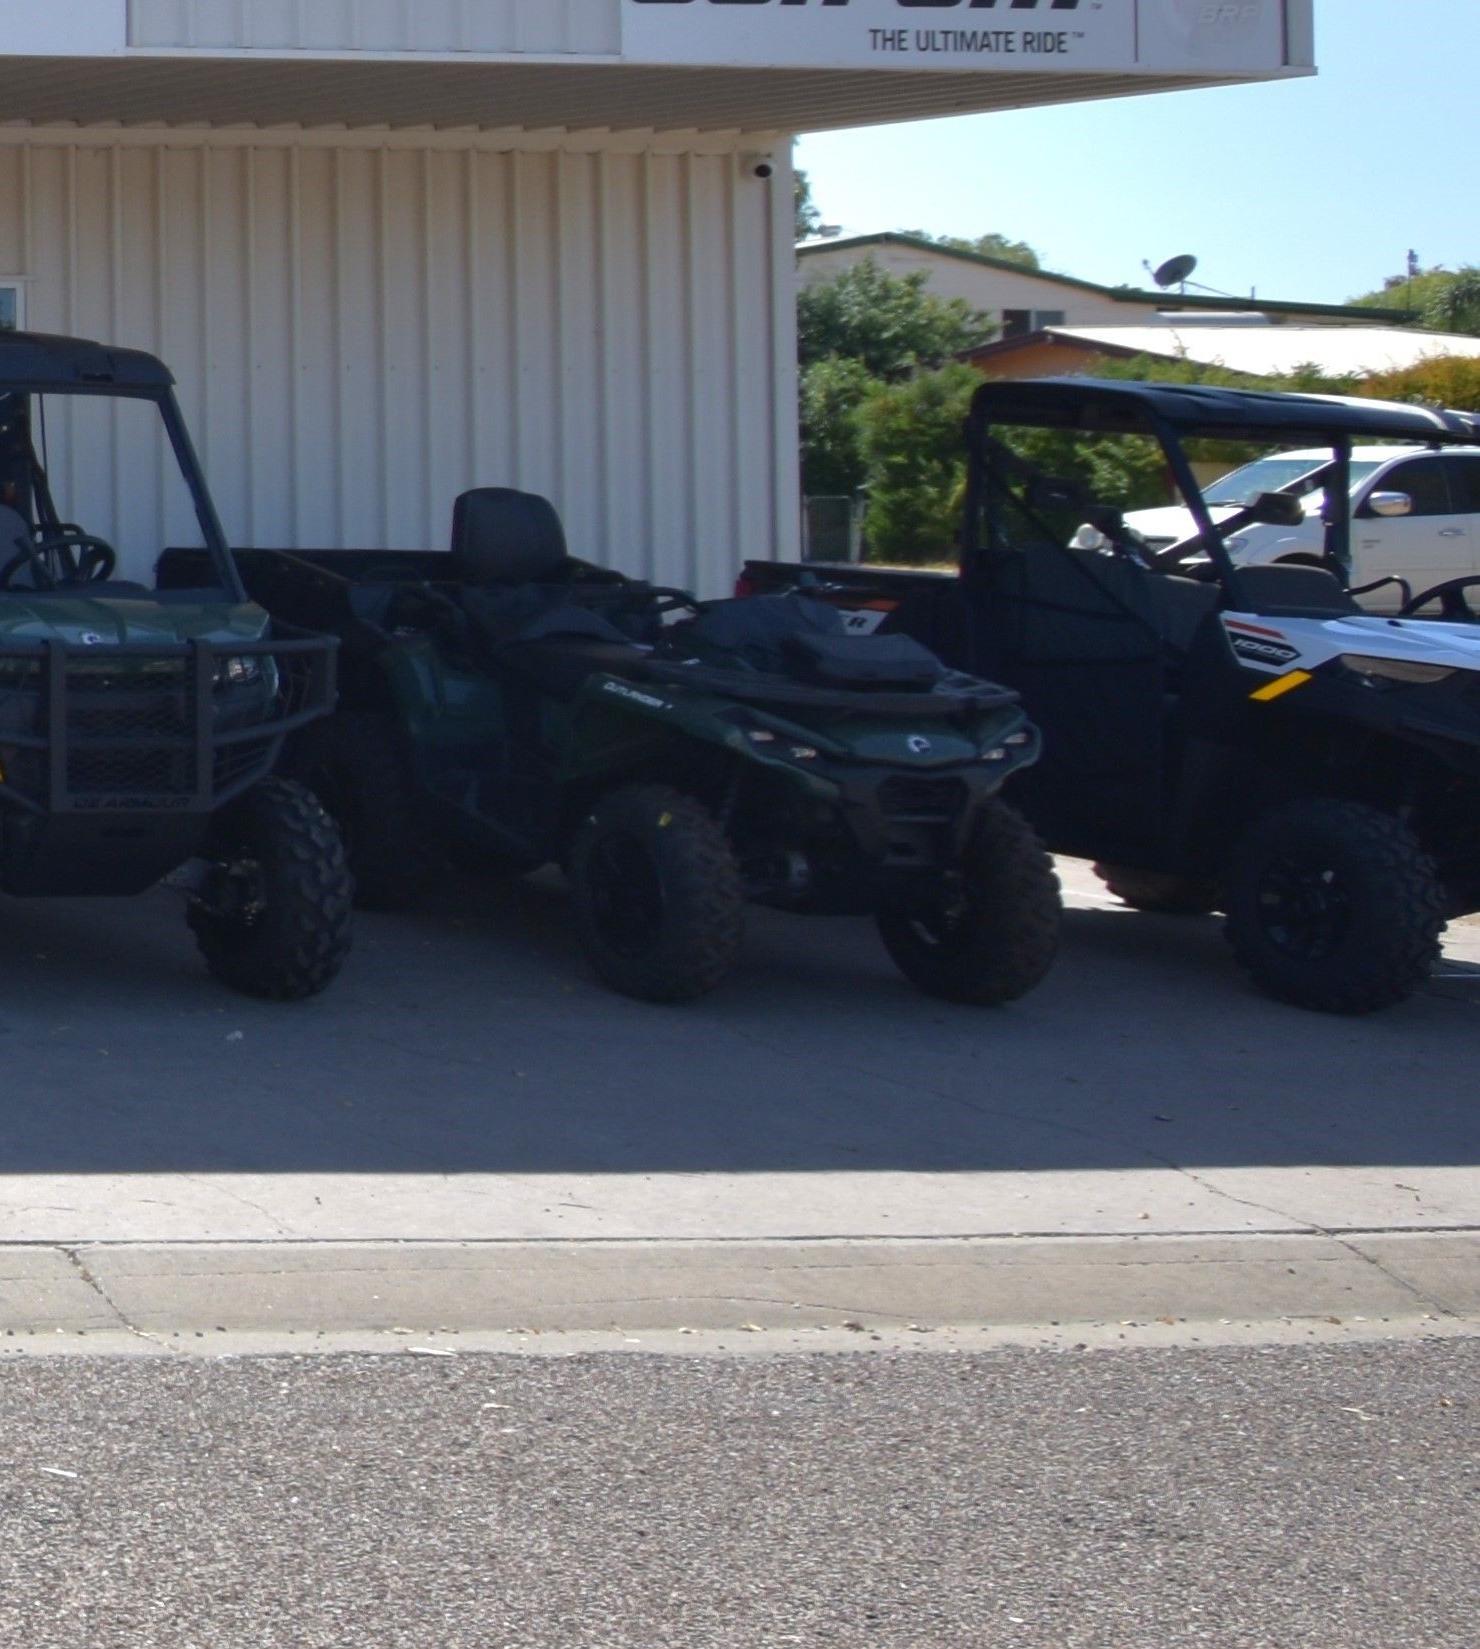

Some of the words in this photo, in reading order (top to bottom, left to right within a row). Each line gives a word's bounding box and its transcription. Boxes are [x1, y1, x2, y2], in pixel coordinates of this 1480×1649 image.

[869, 29, 908, 51] THE
[916, 30, 1015, 53] ULTIMATE
[1233, 638, 1298, 659] 1000
